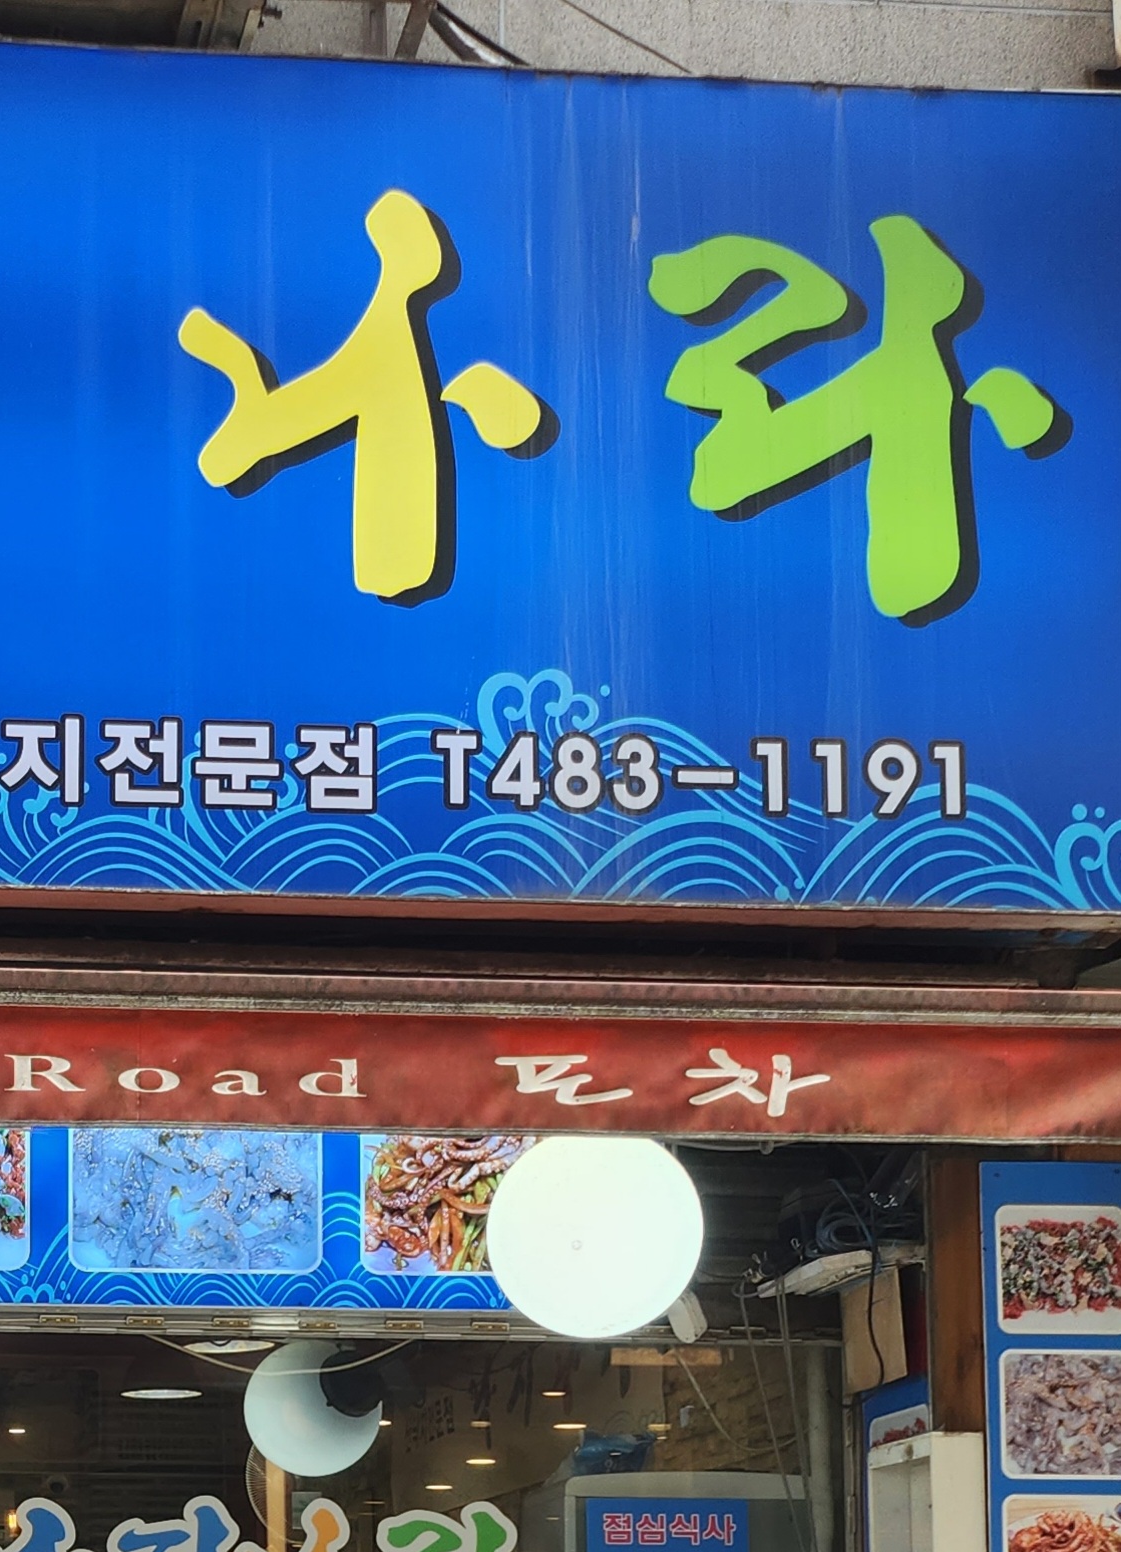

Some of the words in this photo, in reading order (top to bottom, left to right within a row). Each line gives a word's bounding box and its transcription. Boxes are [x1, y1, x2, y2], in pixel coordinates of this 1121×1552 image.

[4, 1053, 367, 1098] Road
[495, 1048, 831, 1117] 포차
[603, 1513, 736, 1546] 점심식사
